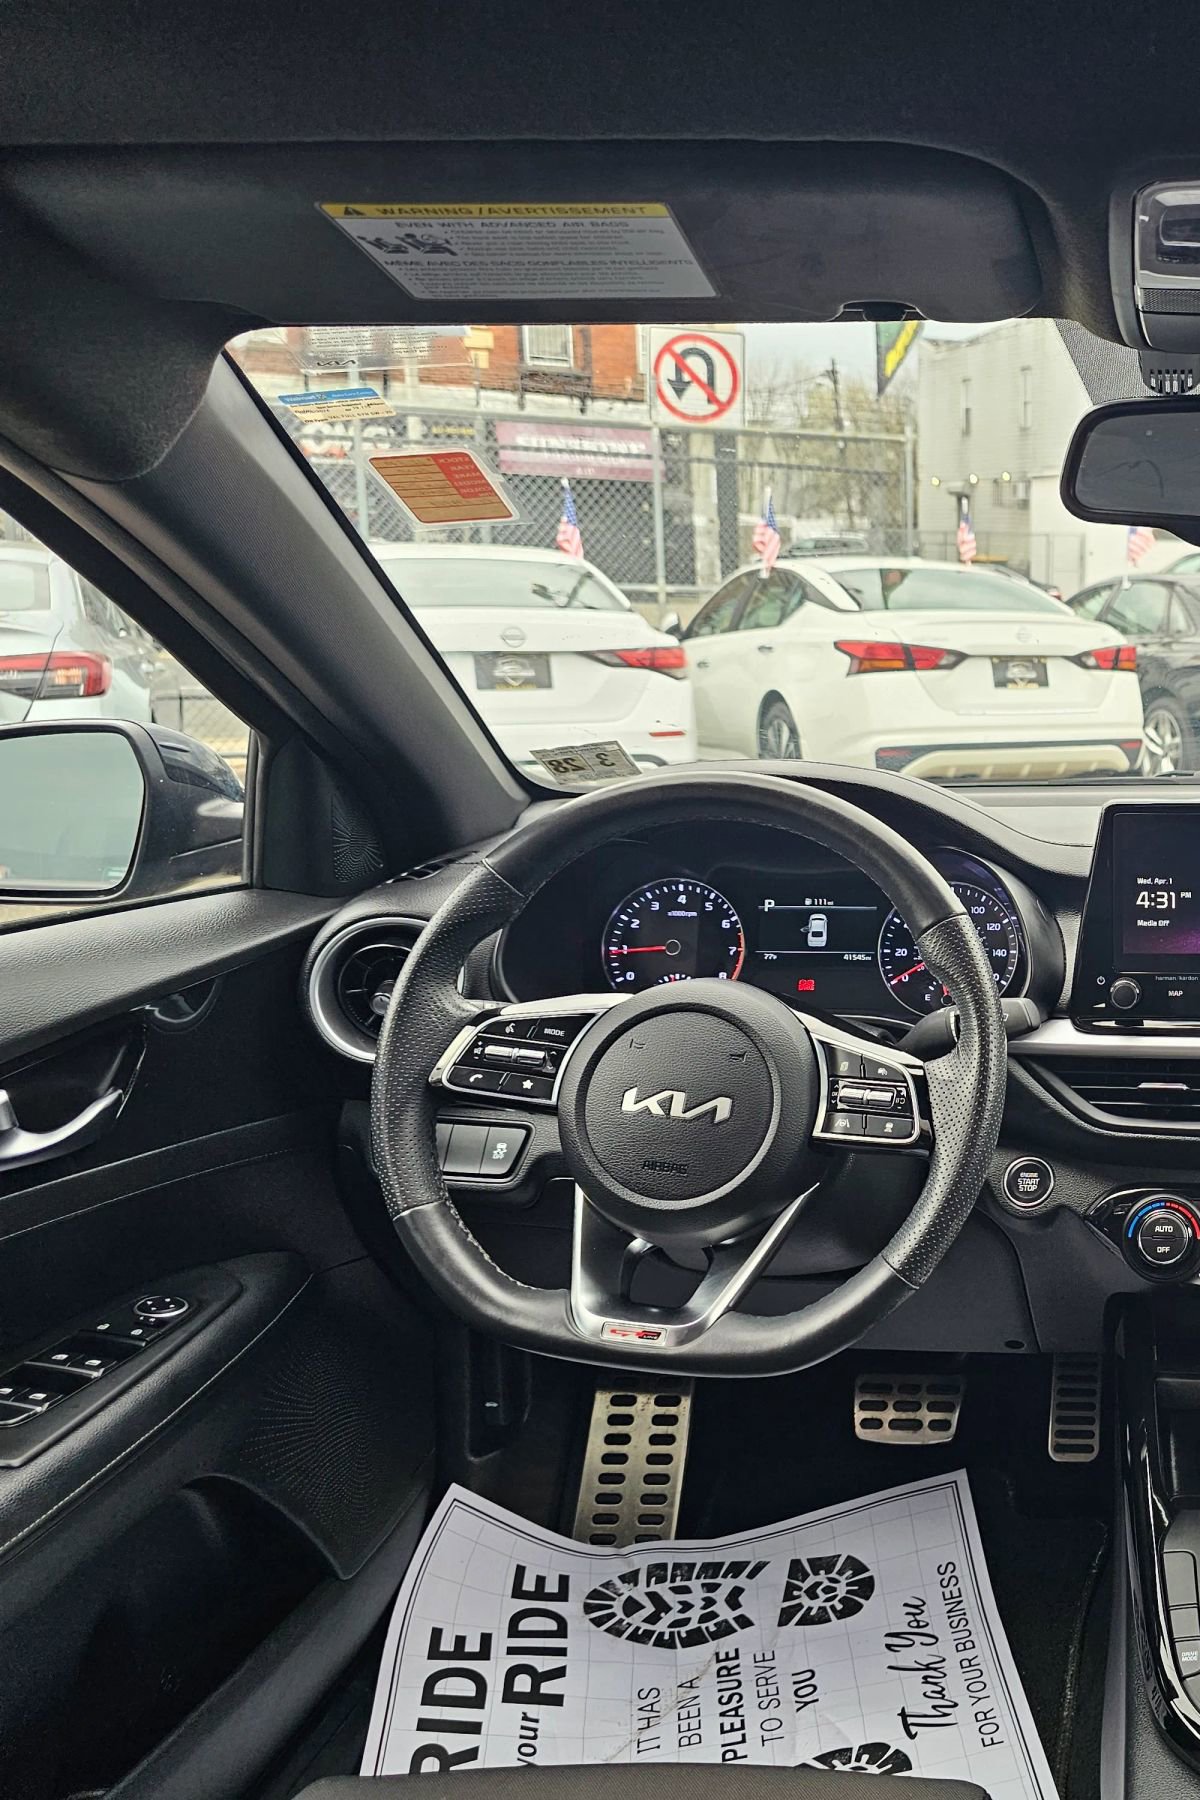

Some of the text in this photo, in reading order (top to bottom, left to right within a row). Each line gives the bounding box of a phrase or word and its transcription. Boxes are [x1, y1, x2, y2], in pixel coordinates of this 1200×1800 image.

[677, 894, 687, 904] 4
[1136, 891, 1176, 909] 4:31
[650, 901, 660, 911] 3
[704, 901, 714, 911] 5
[764, 899, 775, 912] P
[970, 906, 985, 914] 100
[630, 919, 640, 928] 2
[721, 919, 731, 928] 6
[986, 922, 1001, 931] 120
[1136, 919, 1170, 927] Media Off
[728, 946, 737, 955] 7
[894, 948, 908, 957] 20
[992, 948, 1007, 957] 140
[626, 971, 635, 981] 0
[924, 993, 931, 1001] E
[543, 1028, 565, 1037] MODE
[621, 1086, 733, 1124] KIA
[501, 1563, 570, 1707] RIDE
[936, 1560, 1005, 1749] FOR YOUR BUSINESS
[883, 1595, 960, 1740] Thank You
[791, 1668, 820, 1713] YOU
[753, 1649, 785, 1748] TO SERVE
[715, 1647, 749, 1763] PLEASURE
[677, 1675, 702, 1749] BEEN A
[636, 1687, 661, 1755] IT HAS
